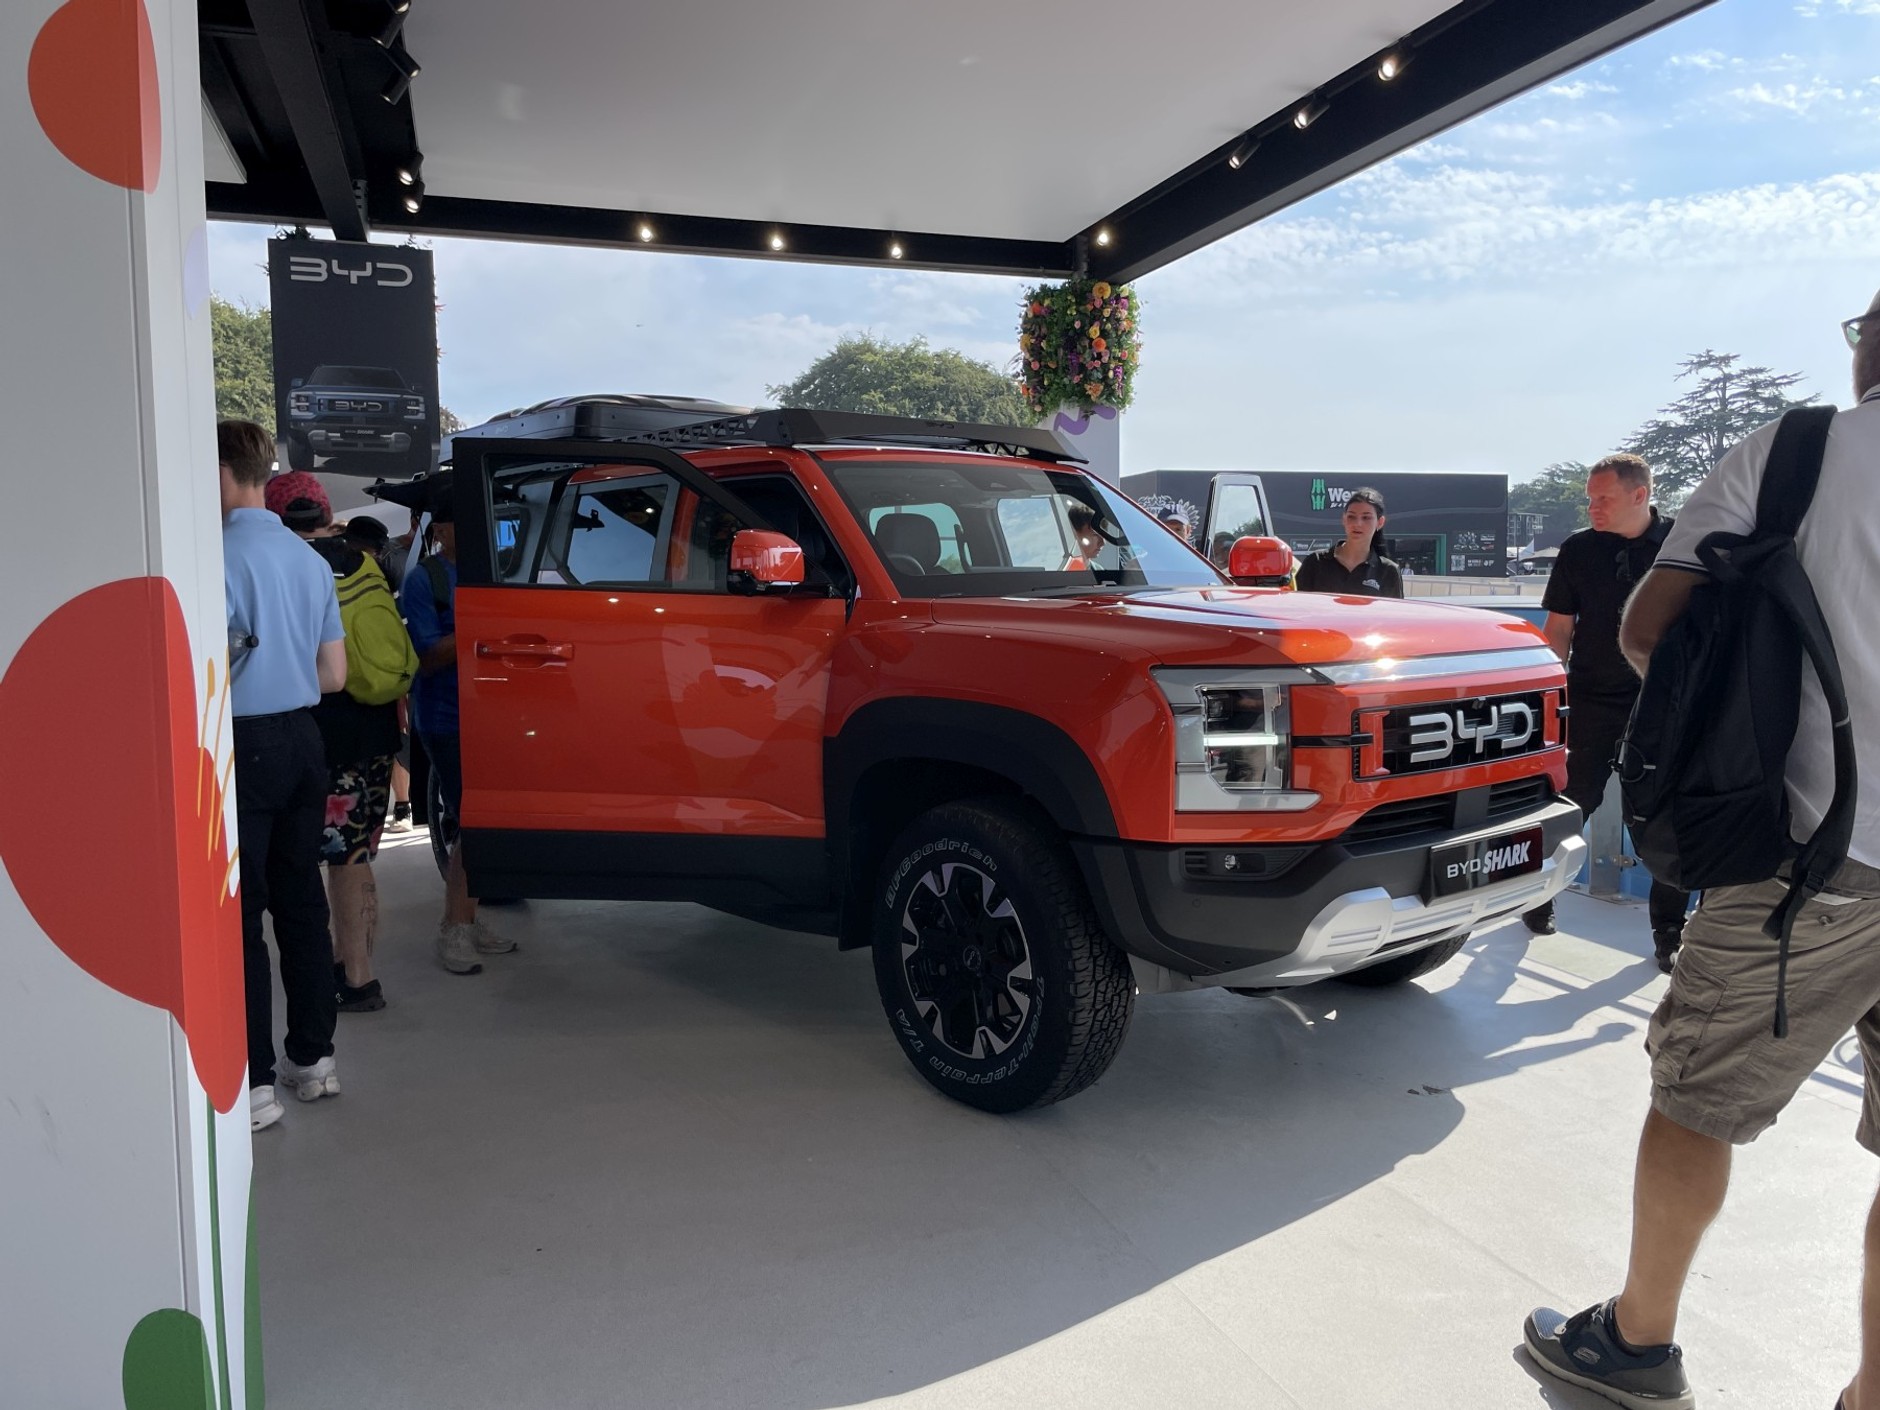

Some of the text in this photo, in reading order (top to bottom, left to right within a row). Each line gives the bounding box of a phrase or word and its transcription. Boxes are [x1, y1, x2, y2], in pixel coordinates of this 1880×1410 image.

[289, 256, 413, 287] BYD
[335, 401, 383, 412] BYD
[1409, 701, 1534, 763] BYD
[1446, 840, 1532, 879] BYD SHARK
